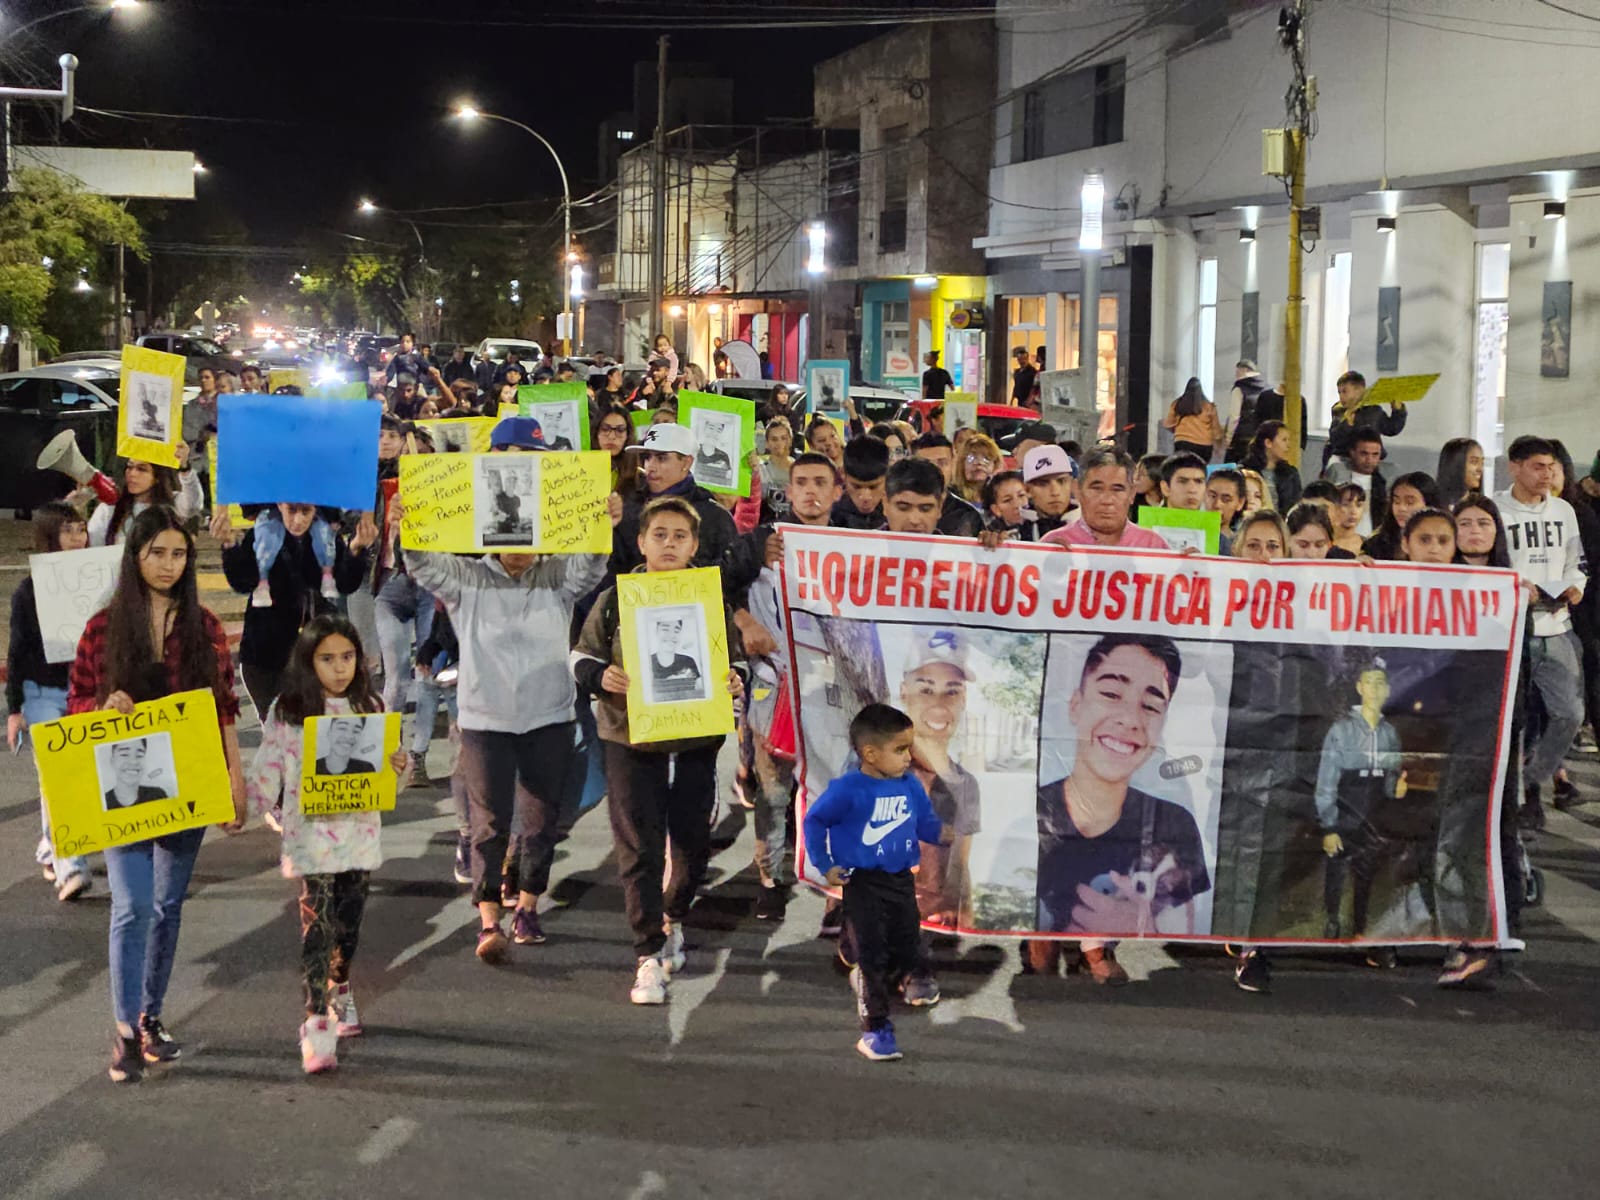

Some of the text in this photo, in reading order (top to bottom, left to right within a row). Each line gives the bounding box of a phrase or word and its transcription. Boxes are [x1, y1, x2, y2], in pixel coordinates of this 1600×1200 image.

[1508, 520, 1563, 550] THET
[796, 550, 1041, 617] !!QUEREMOS
[1223, 578, 1296, 630] POR
[871, 795, 908, 822] NIKE
[876, 839, 913, 857] AIR
